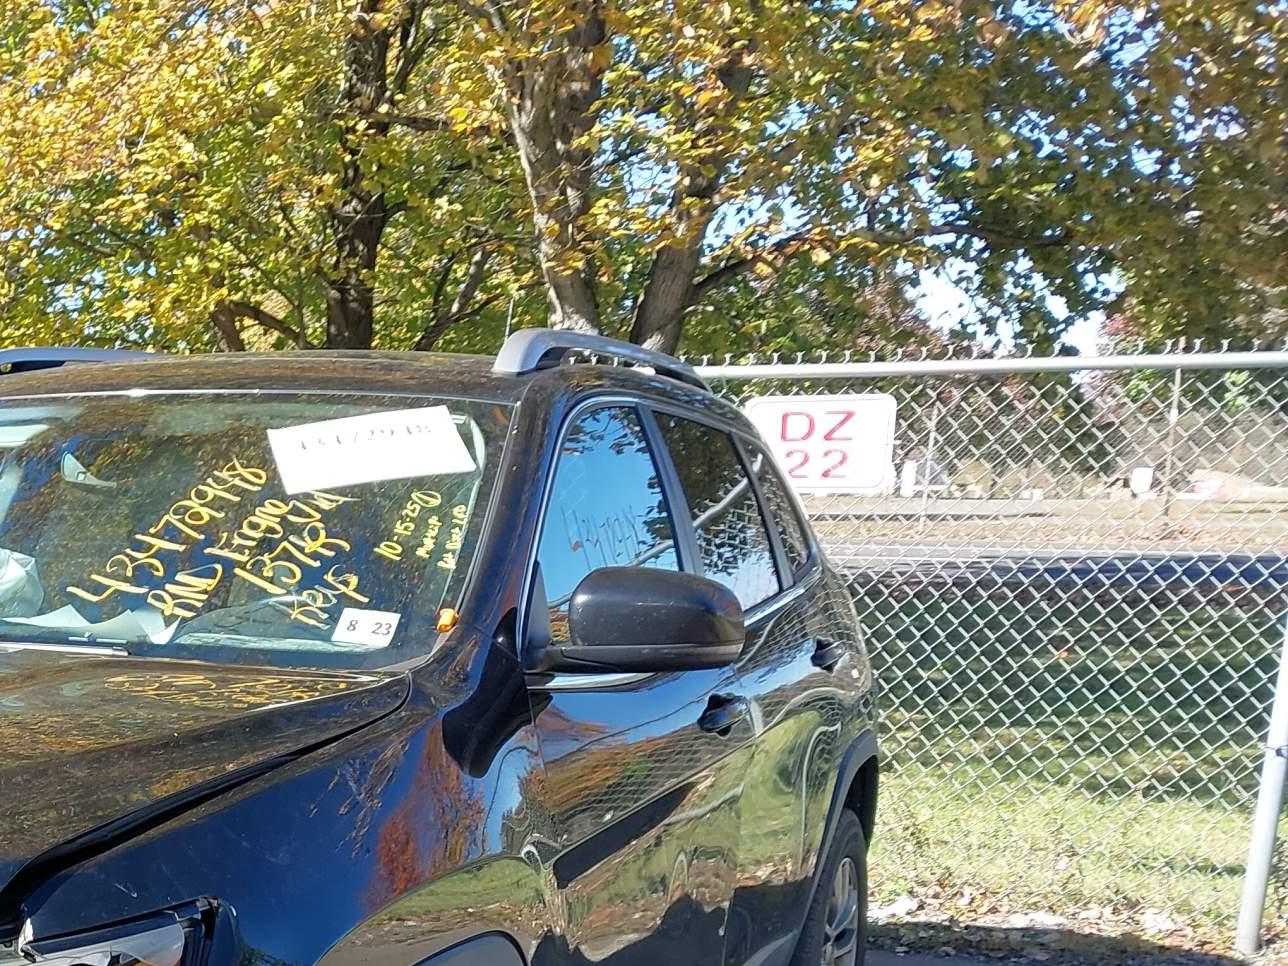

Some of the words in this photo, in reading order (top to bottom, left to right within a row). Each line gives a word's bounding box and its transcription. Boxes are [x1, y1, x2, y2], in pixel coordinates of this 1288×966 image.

[780, 410, 856, 441] DZ
[784, 449, 848, 478] 22
[66, 456, 266, 602] 43472948
[346, 619, 359, 633] 8
[370, 622, 393, 636] 23
